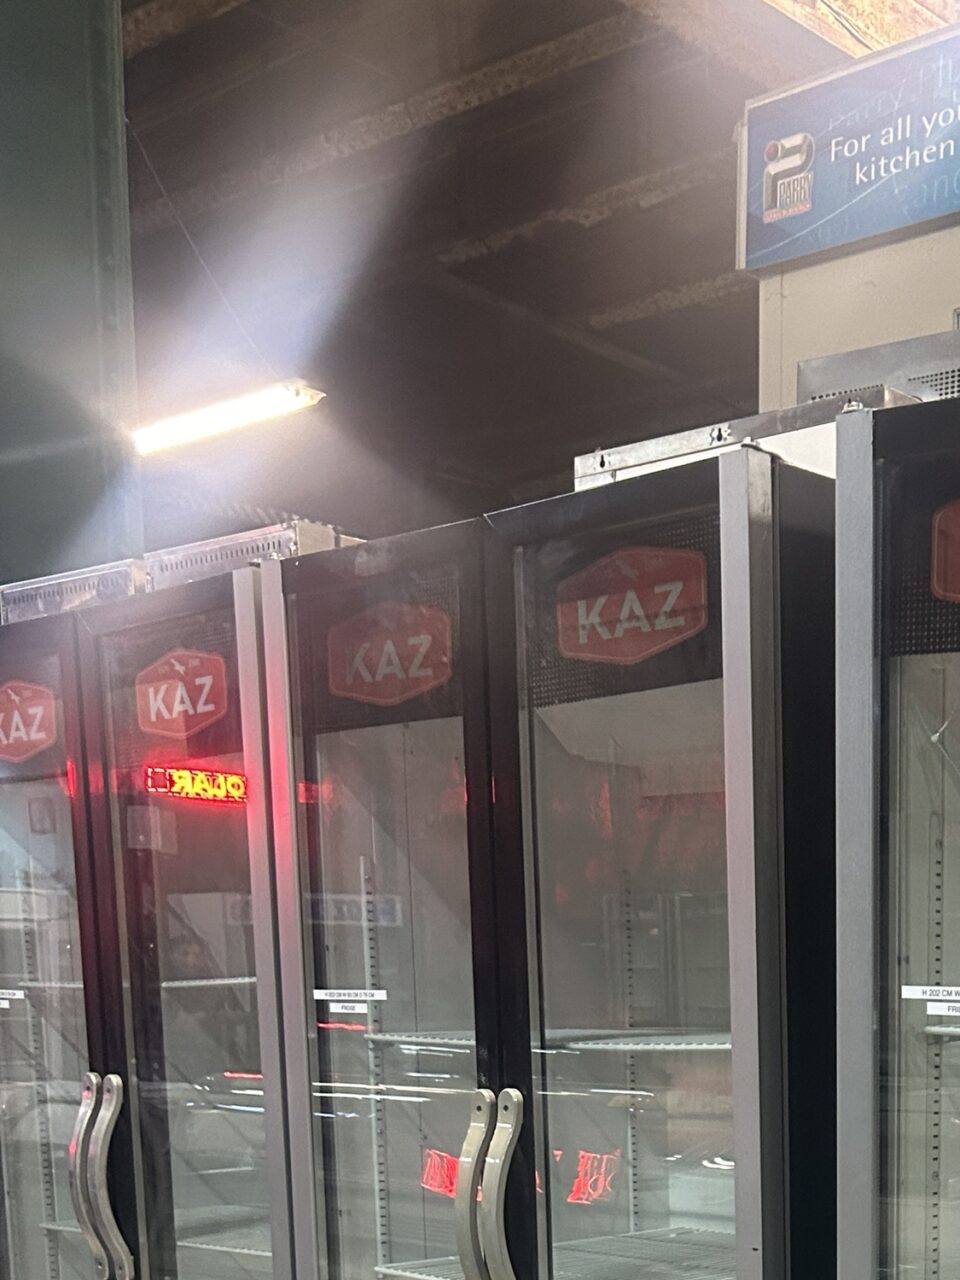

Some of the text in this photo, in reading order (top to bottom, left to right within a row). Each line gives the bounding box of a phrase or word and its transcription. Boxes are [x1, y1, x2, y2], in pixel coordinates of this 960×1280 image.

[830, 134, 871, 161] For
[880, 115, 911, 147] all
[856, 138, 954, 185] kitchen
[778, 173, 813, 209] PARRY
[576, 581, 685, 644] KAZ
[345, 634, 434, 684] KAZ
[149, 675, 216, 722] KAZ
[928, 989, 941, 997] 202
[942, 989, 953, 997] CM
[954, 989, 960, 997] W
